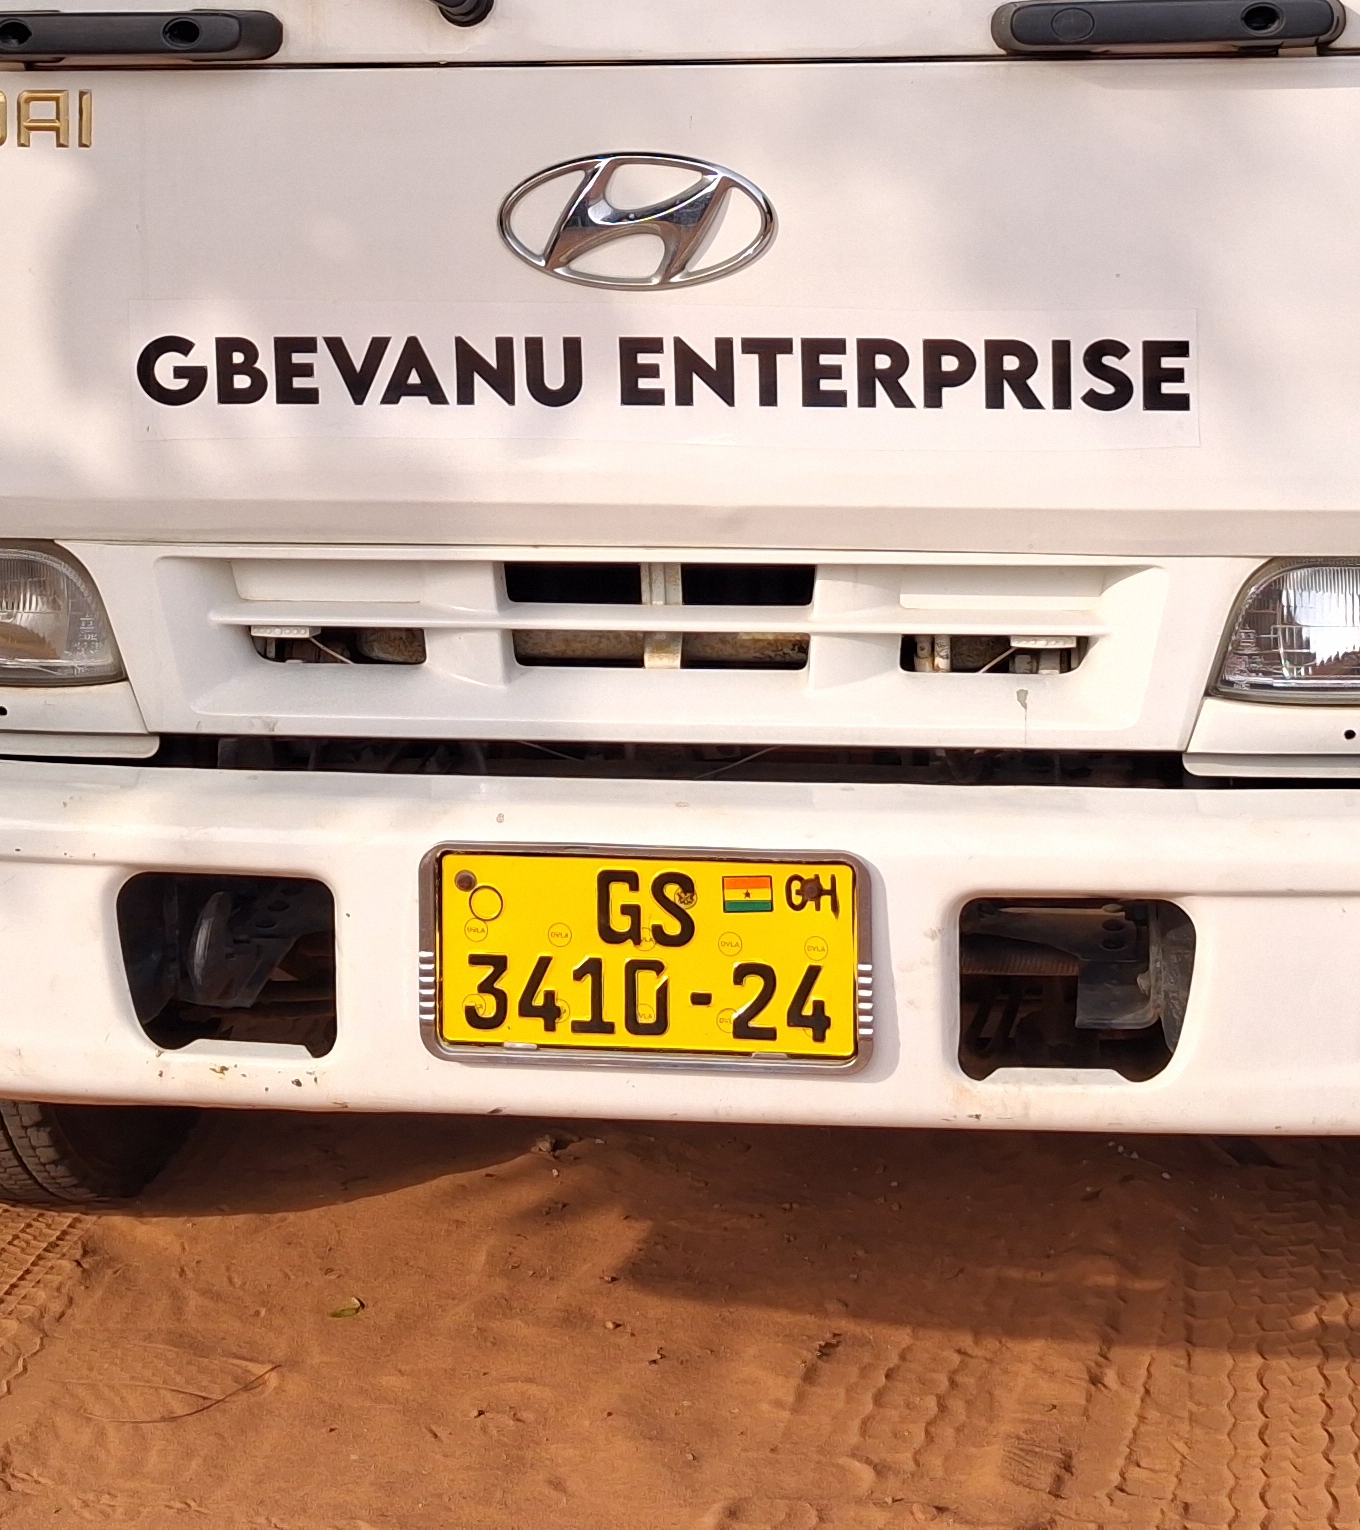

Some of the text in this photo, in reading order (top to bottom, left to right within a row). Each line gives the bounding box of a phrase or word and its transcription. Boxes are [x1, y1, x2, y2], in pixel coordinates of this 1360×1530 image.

[136, 335, 1191, 412] GBEVANU ENTERPRISE
[597, 869, 841, 947] GS GH
[464, 954, 832, 1043] 3410-24
